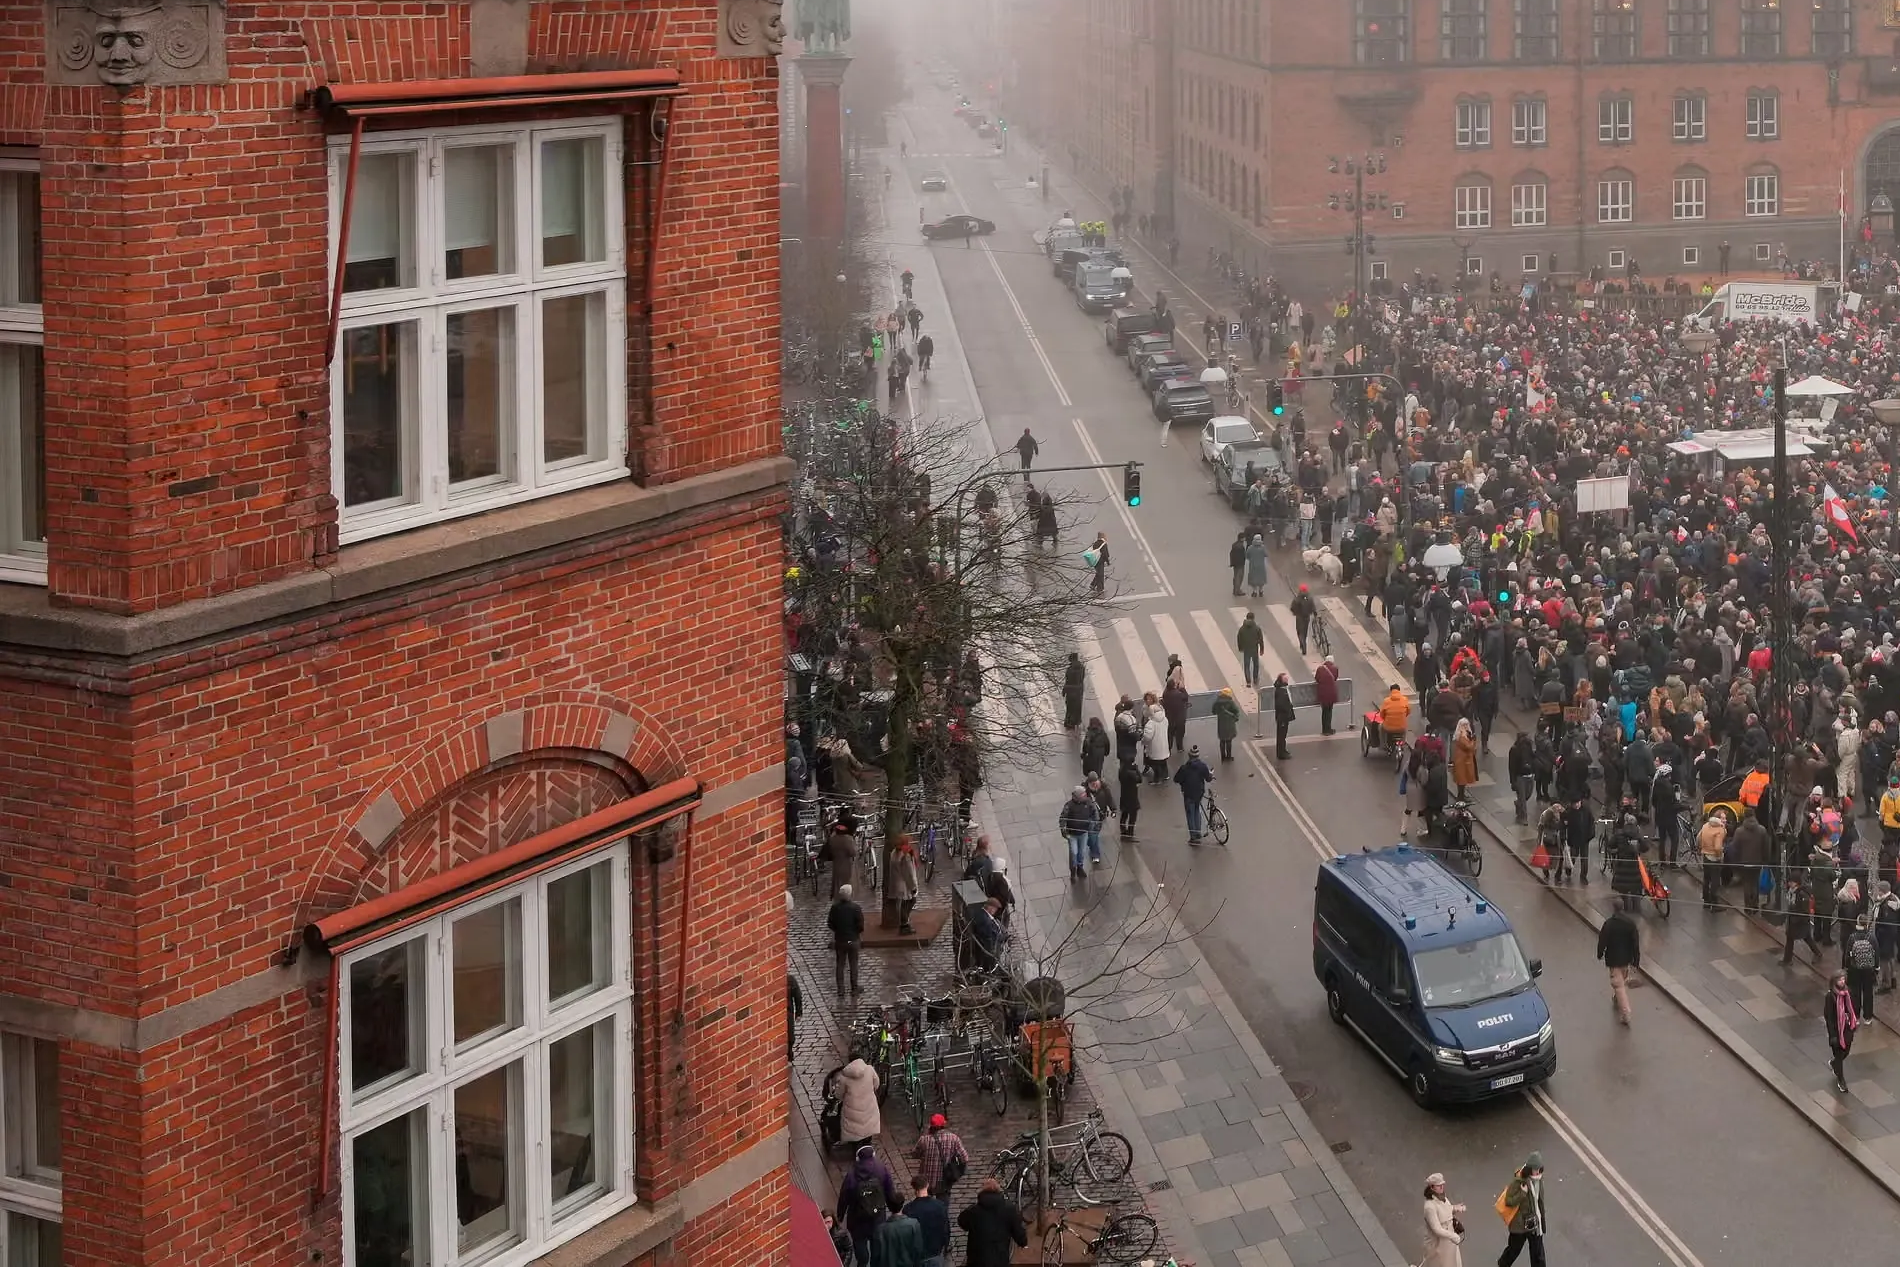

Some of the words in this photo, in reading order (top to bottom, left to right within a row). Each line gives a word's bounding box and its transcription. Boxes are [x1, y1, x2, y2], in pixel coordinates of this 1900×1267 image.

[1736, 293, 1807, 305] McBride
[1231, 324, 1239, 334] P
[1477, 1013, 1514, 1029] POLITI
